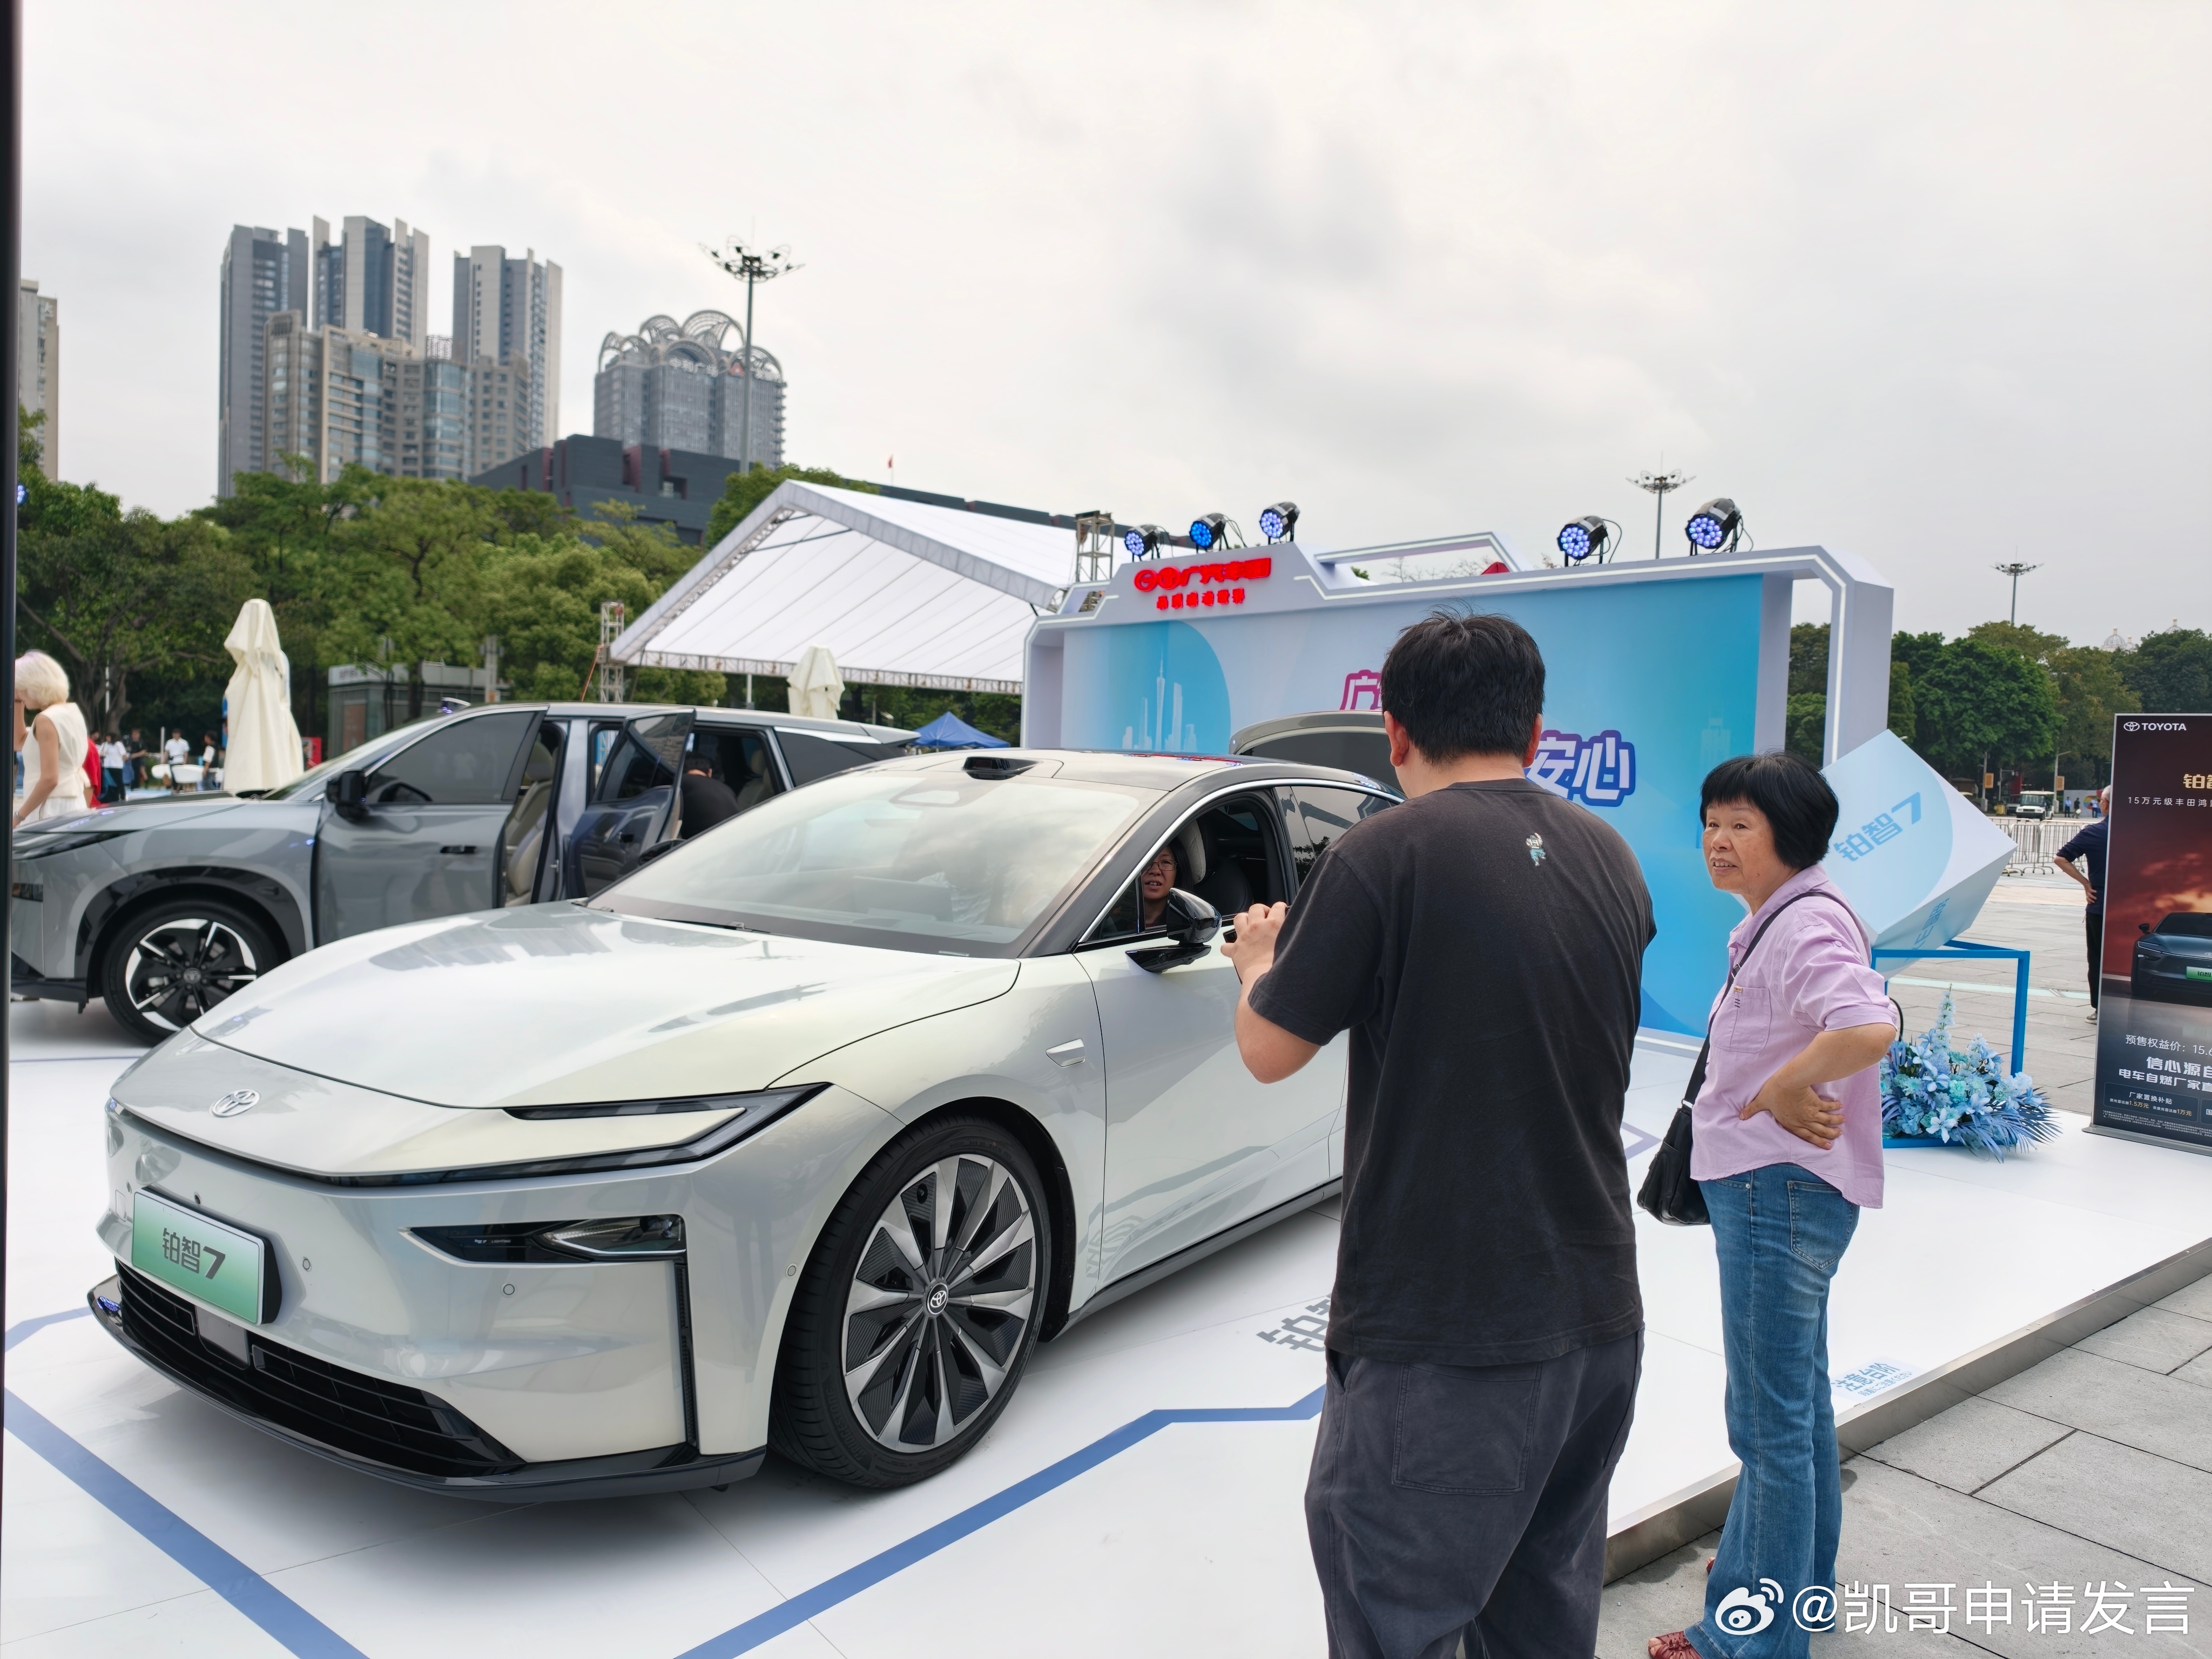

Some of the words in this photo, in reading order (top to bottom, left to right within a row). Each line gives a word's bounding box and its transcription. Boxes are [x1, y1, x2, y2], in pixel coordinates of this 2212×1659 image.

[2141, 723, 2187, 731] TOYOTA
[2128, 797, 2212, 808] 15万元级丰田鸿
[1833, 791, 1921, 861] 铂智7
[2129, 1091, 2173, 1105] 厂家置换补贴
[162, 1228, 226, 1279] 铂智7
[1830, 1363, 1901, 1392] 注意台阶
